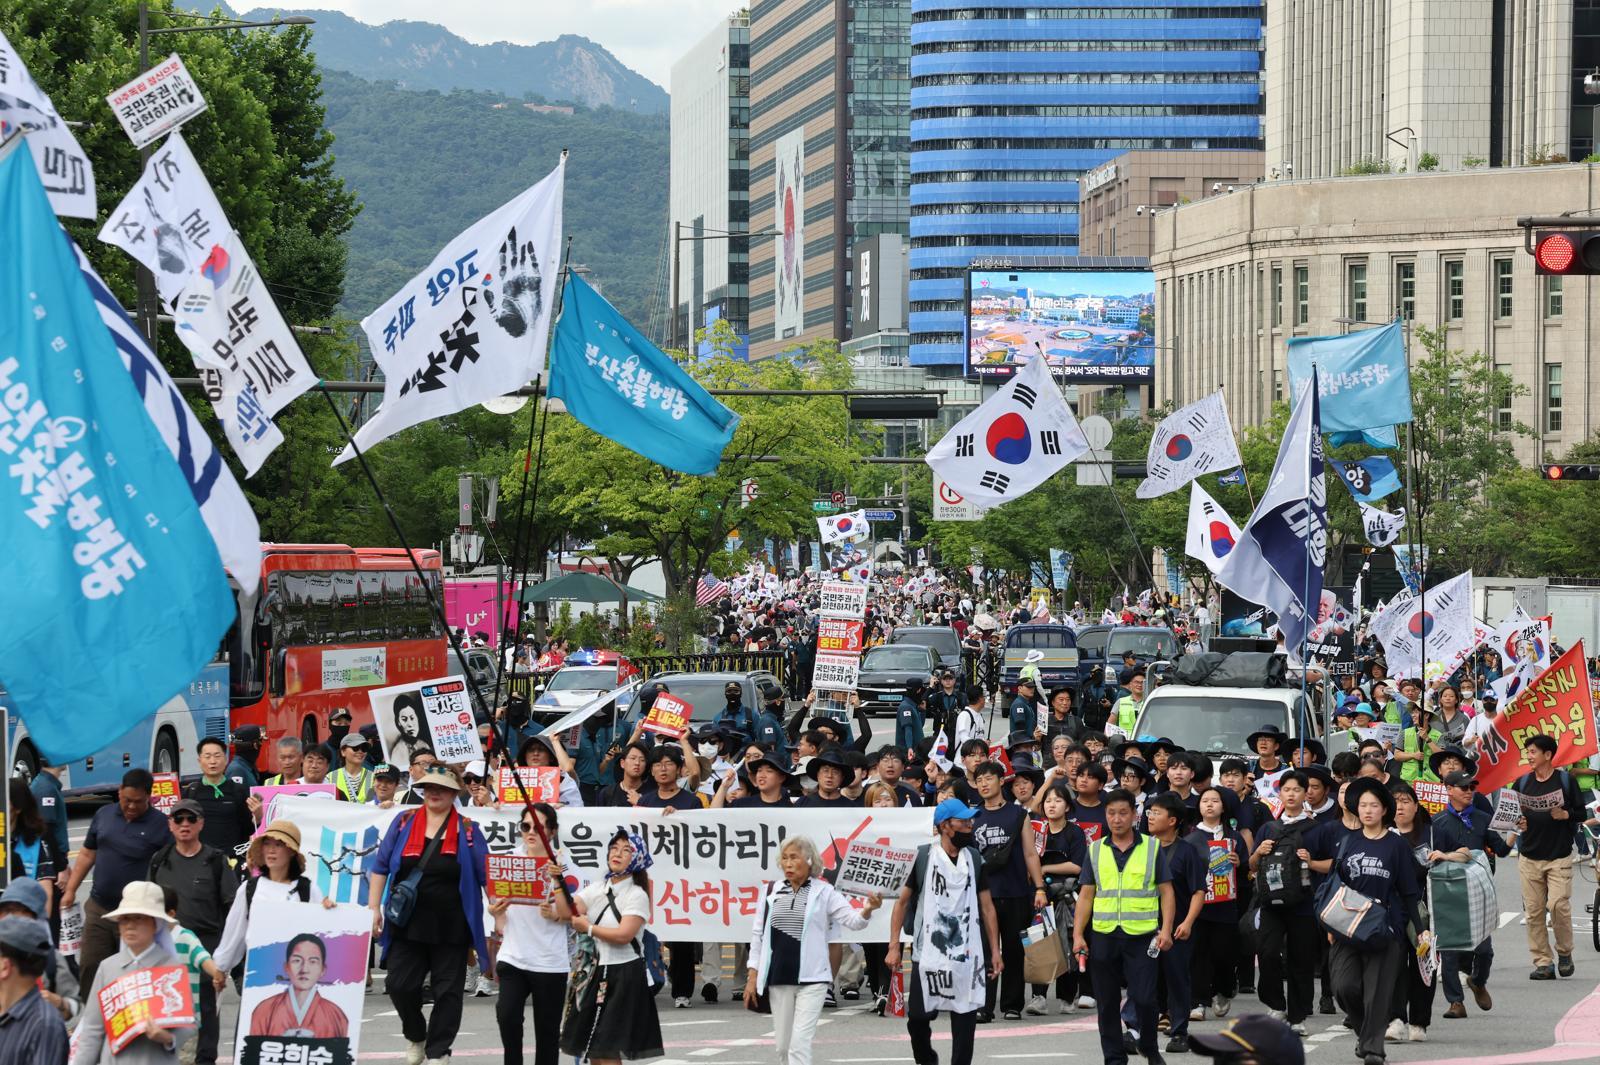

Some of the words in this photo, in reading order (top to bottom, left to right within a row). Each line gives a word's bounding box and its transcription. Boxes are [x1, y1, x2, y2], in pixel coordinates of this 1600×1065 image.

[114, 82, 147, 105] 자주독립
[147, 62, 180, 86] 정신으로
[120, 84, 172, 119] 국민주권
[130, 97, 179, 132] 실현하자
[584, 342, 688, 420] 부산촛불행동
[822, 593, 852, 602] 국민주권
[821, 602, 852, 611] 실현하자
[819, 622, 847, 630] 한미연합
[819, 630, 847, 638] 군사훈련
[820, 638, 843, 649] 중단!
[816, 664, 845, 673] 국민주권
[815, 673, 844, 682] 실현하자
[434, 723, 459, 737] 진정한
[440, 745, 475, 758] 이룩하자!
[851, 845, 883, 857] 자주독립
[885, 850, 914, 862] 정신으로
[488, 857, 536, 869] 한미연합
[847, 856, 896, 875] 국민주권
[488, 868, 537, 881] 군사훈련
[842, 869, 892, 888] 실현하자
[494, 881, 532, 897] 중단!
[100, 970, 152, 1004] 한미연합
[111, 1000, 149, 1038] 중단!
